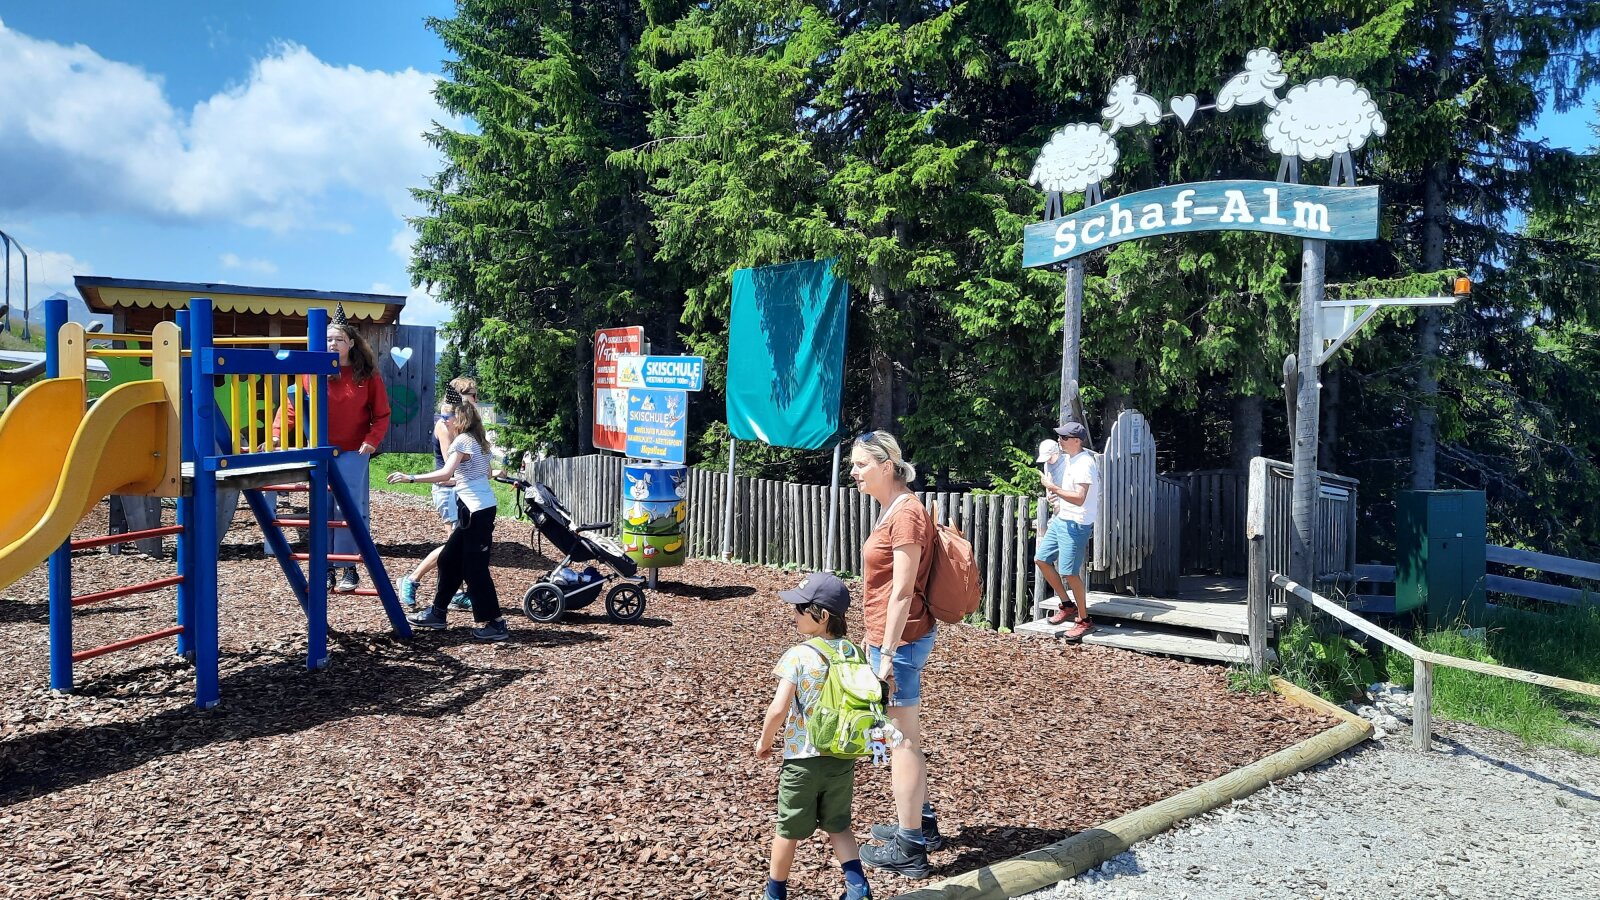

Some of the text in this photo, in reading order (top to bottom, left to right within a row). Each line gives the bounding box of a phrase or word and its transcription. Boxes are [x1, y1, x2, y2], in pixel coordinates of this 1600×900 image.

[1053, 187, 1332, 258] Schaf-Alm
[646, 361, 700, 377] SKISCHULE
[630, 410, 670, 423] SKISCHULE
